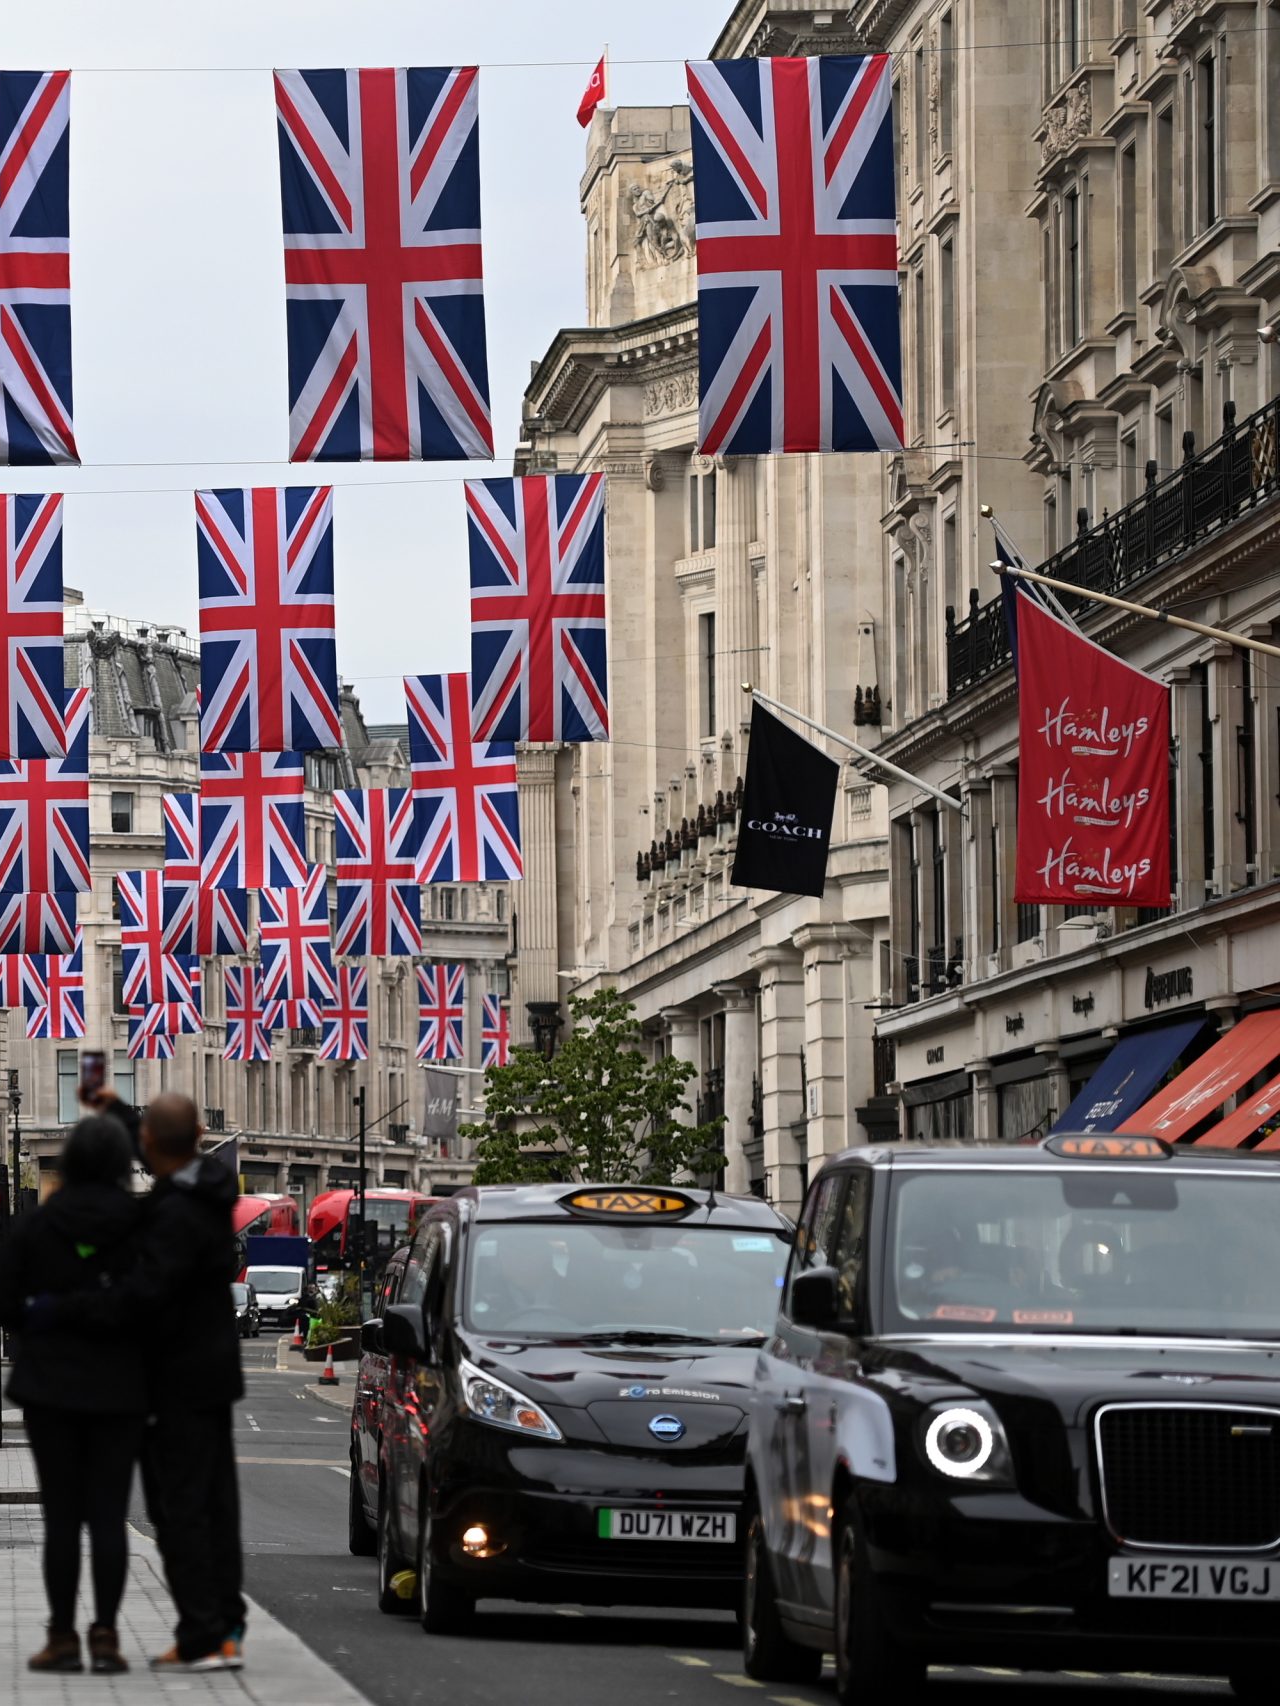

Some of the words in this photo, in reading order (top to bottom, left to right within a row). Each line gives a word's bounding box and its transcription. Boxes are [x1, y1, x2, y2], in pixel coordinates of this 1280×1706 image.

[1037, 696, 1149, 758] Hamleys
[1037, 767, 1150, 828] Hamleys
[747, 820, 822, 839] COACH
[1036, 836, 1151, 898] Hamleys
[1068, 1138, 1153, 1155] TAXI
[588, 1195, 667, 1212] TAXI
[662, 1388, 720, 1400] Emission
[620, 1513, 672, 1536] DU71
[681, 1515, 726, 1538] WZH
[1128, 1564, 1198, 1594] KF21
[1209, 1566, 1270, 1595] VGJ
